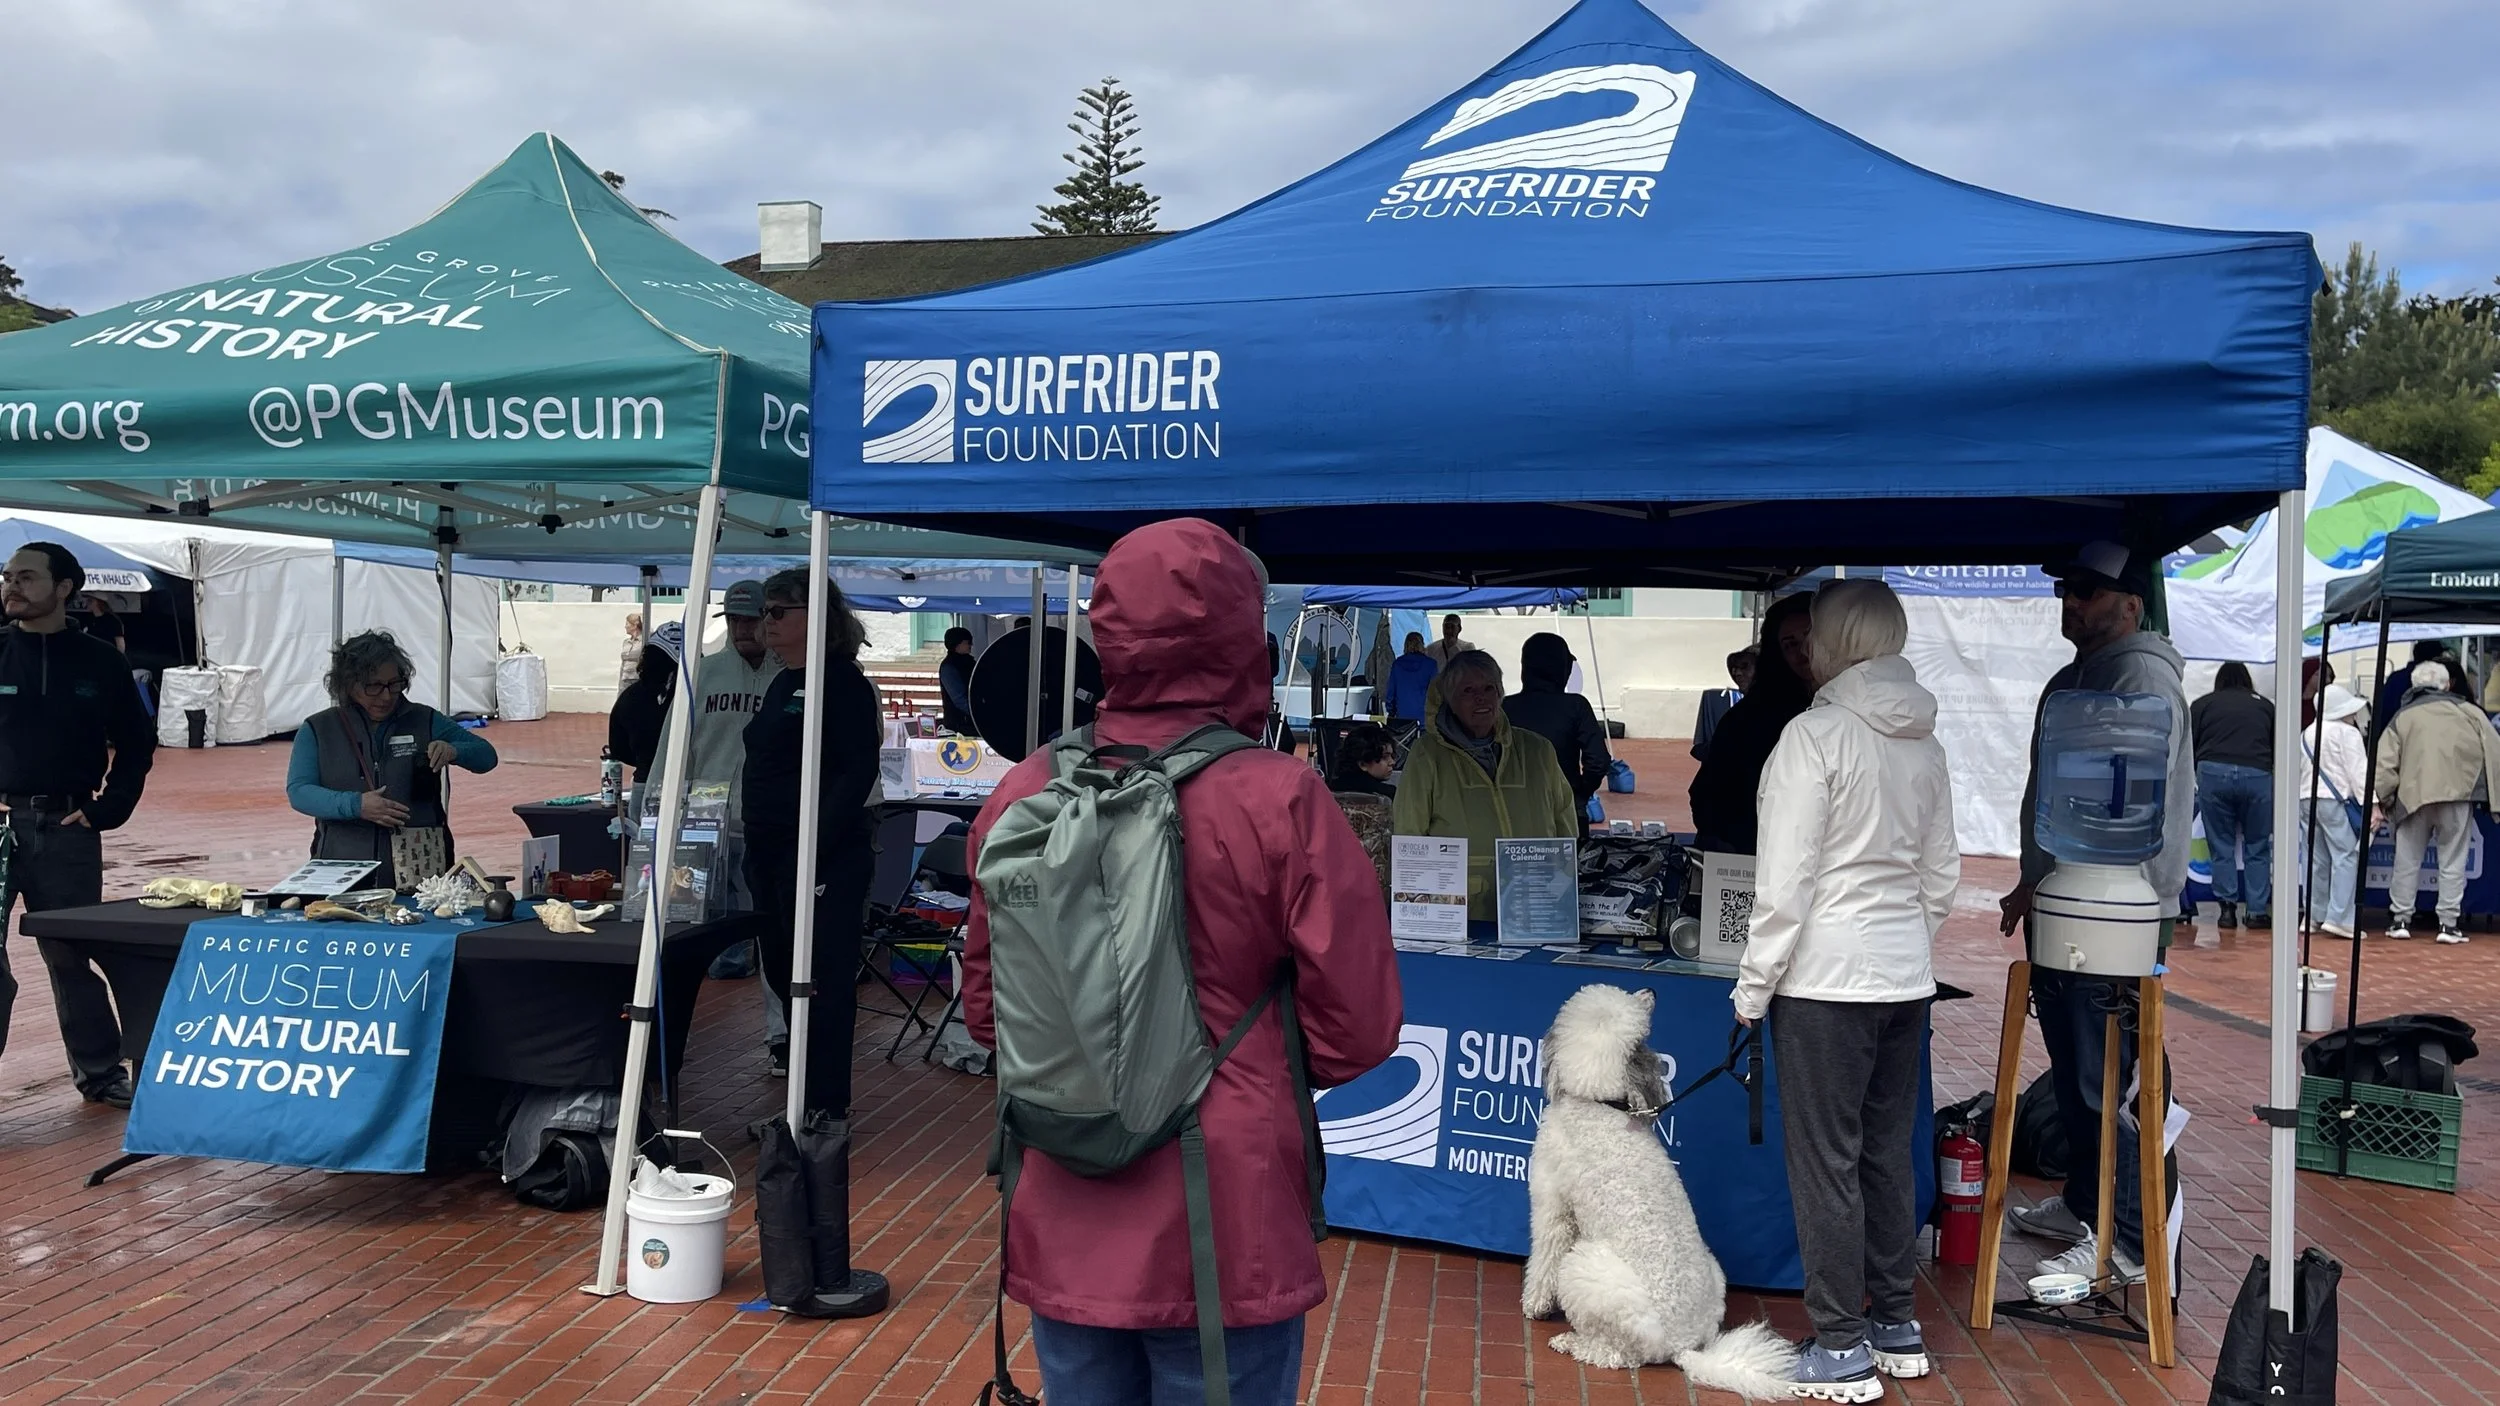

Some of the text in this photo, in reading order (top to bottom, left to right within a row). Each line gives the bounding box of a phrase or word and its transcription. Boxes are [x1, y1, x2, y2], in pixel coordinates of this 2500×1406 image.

[1380, 173, 1657, 205] SURFRIDER
[1366, 200, 1650, 223] FOUNDATION
[223, 256, 572, 307] USEUM
[416, 250, 560, 283] GROVE
[176, 287, 486, 331] NATURAL
[70, 317, 381, 361] HISTORY
[965, 350, 1222, 417] SURFRIDER
[248, 381, 666, 450] @PGMuseum
[963, 421, 1221, 463] FOUNDATION
[87, 573, 132, 586] THE WHALES
[1965, 581, 1990, 589] wildlife
[1991, 581, 2006, 589] and
[2007, 581, 2025, 589] their
[705, 692, 763, 714] MONTE
[1504, 845, 1560, 855] 2026 Cleanup
[1510, 854, 1546, 862] Calendar
[1742, 870, 1756, 879] EMA
[1598, 902, 1610, 911] the
[203, 936, 414, 959] PACIFIC GROVE
[187, 960, 430, 1012] MUSEUM
[174, 1015, 411, 1057] of NATURAL
[155, 1050, 356, 1099] HISTORY
[1448, 1145, 1533, 1182] MONTER
